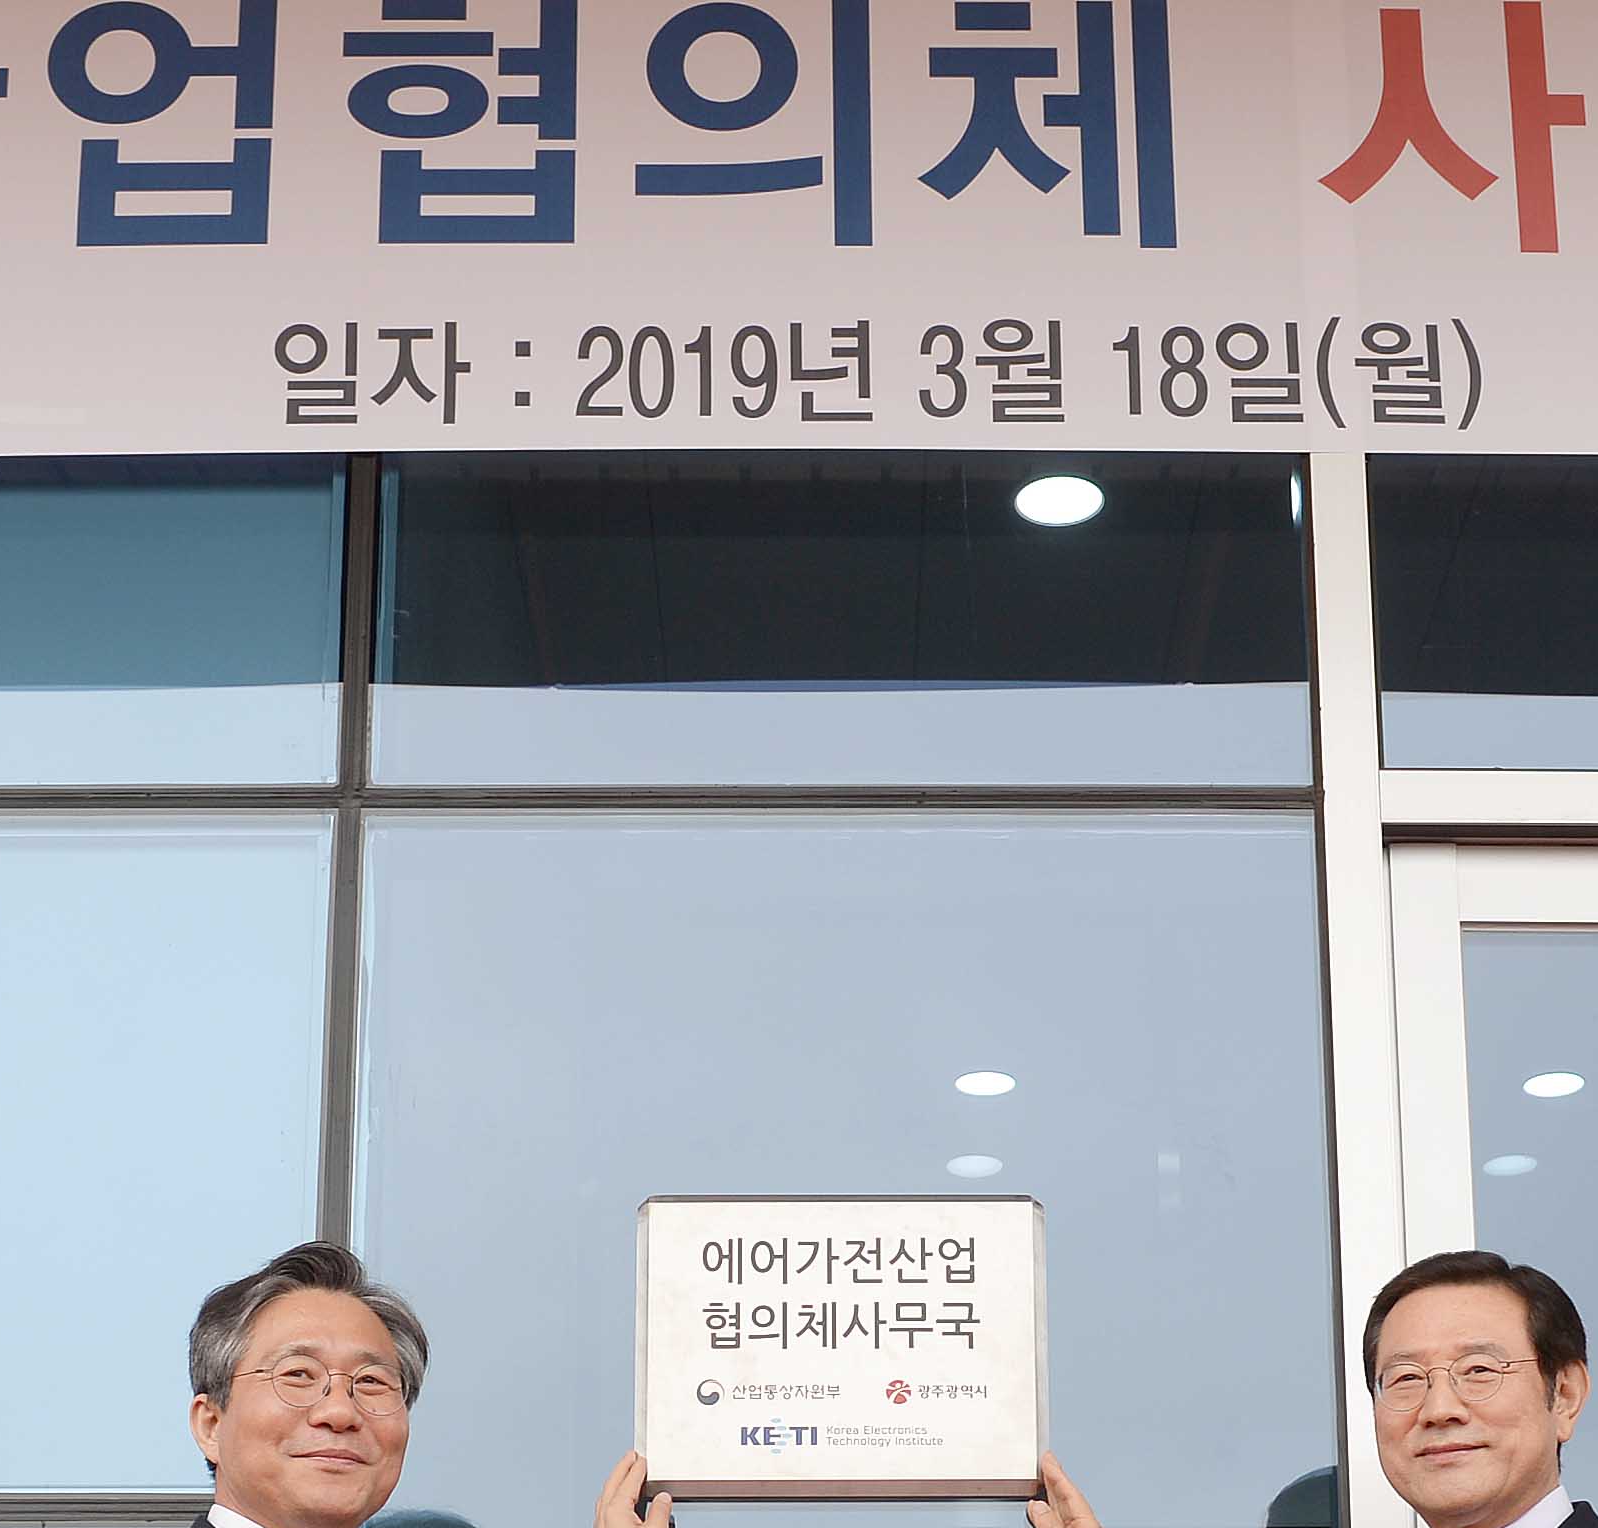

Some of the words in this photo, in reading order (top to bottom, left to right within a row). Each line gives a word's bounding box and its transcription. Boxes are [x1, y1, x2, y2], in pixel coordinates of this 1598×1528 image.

[275, 322, 471, 424] 일자
[576, 320, 873, 421] 2019년
[919, 319, 1065, 422] 3월
[1113, 317, 1481, 430] 18일(월)
[703, 1237, 976, 1285] 에어가전산업
[703, 1301, 981, 1350] 협의체사무국
[732, 1384, 841, 1401] 산업통상자원부
[918, 1384, 987, 1400] 광주광역시
[740, 1426, 818, 1446] KETI
[826, 1425, 859, 1435] Korea
[863, 1425, 928, 1435] Electronics
[826, 1436, 891, 1448] Technology
[895, 1436, 944, 1446] Institute
